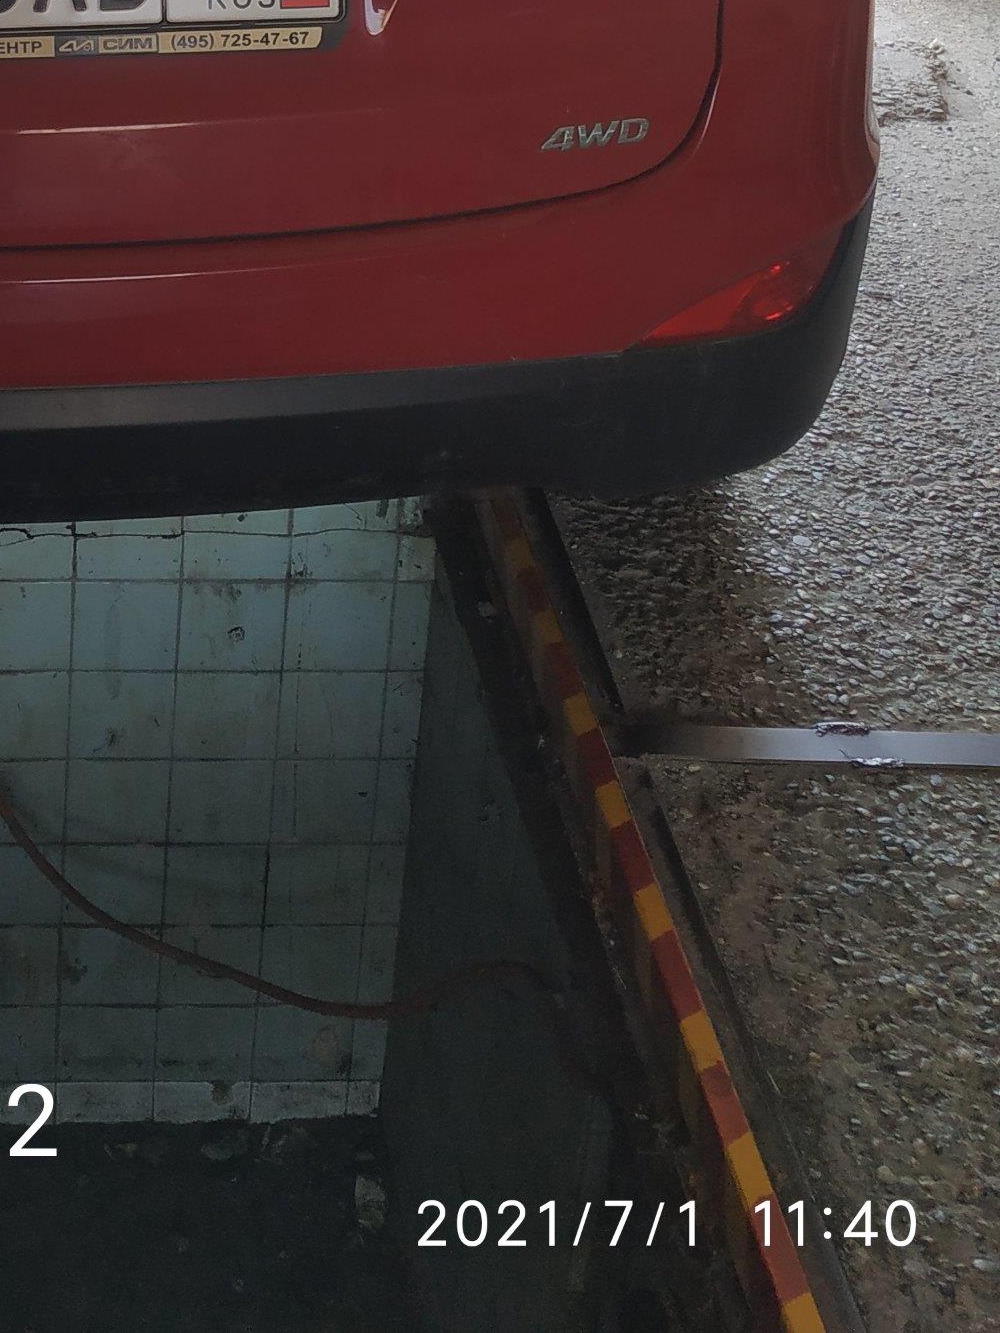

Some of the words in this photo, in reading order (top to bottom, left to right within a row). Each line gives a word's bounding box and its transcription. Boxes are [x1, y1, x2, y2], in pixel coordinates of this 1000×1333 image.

[102, 37, 153, 51] СИМ
[171, 33, 215, 50] (495)
[221, 31, 310, 47] 725-47-67
[540, 117, 650, 151] 4WD
